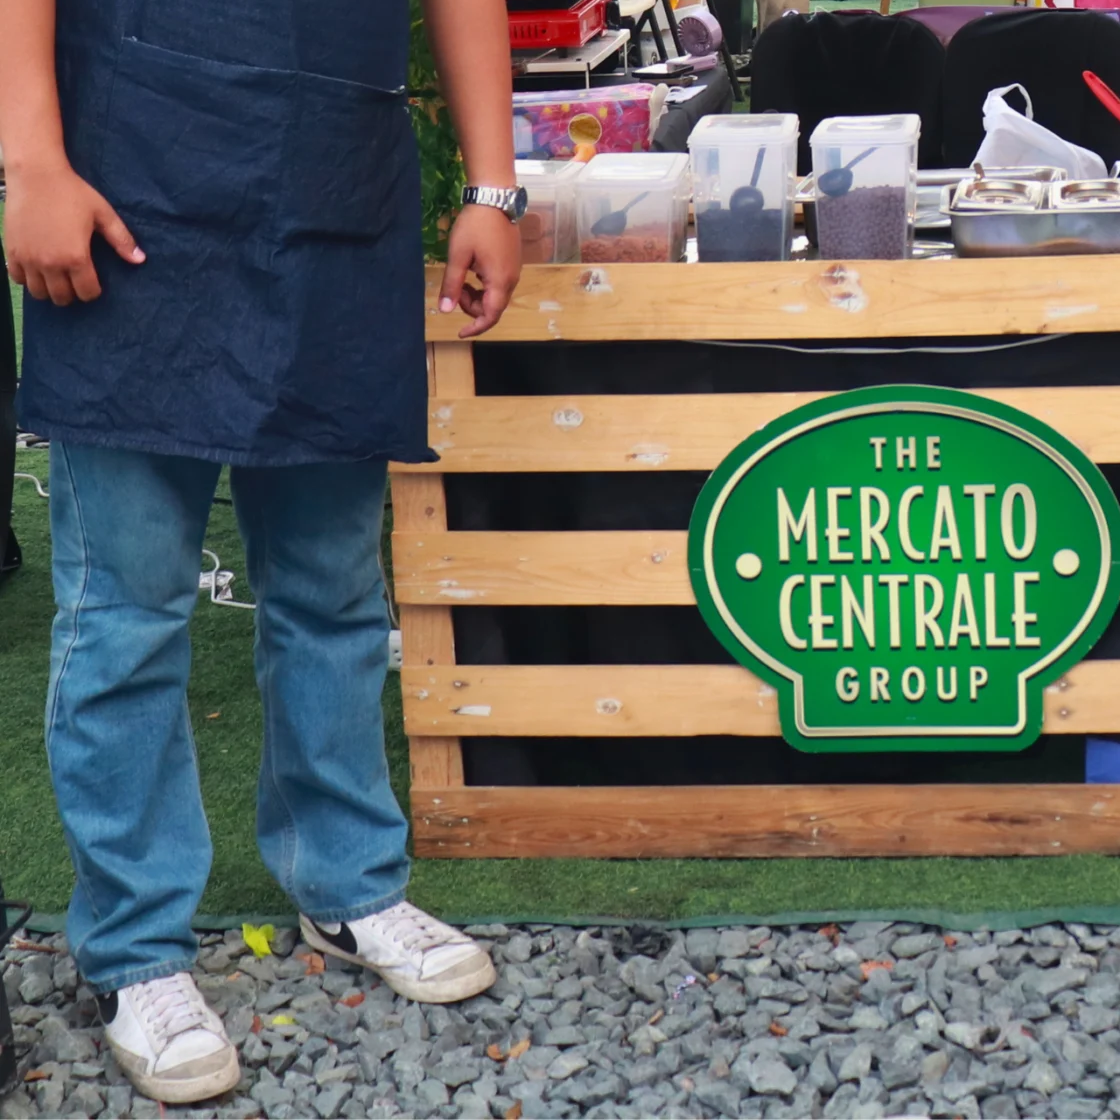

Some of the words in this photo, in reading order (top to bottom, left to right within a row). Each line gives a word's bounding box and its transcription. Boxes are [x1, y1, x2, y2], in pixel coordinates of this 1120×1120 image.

[869, 436, 941, 471] THE
[776, 483, 1038, 564] MERCATO
[778, 571, 1041, 650] CENTRALE
[835, 666, 989, 703] GROUP
